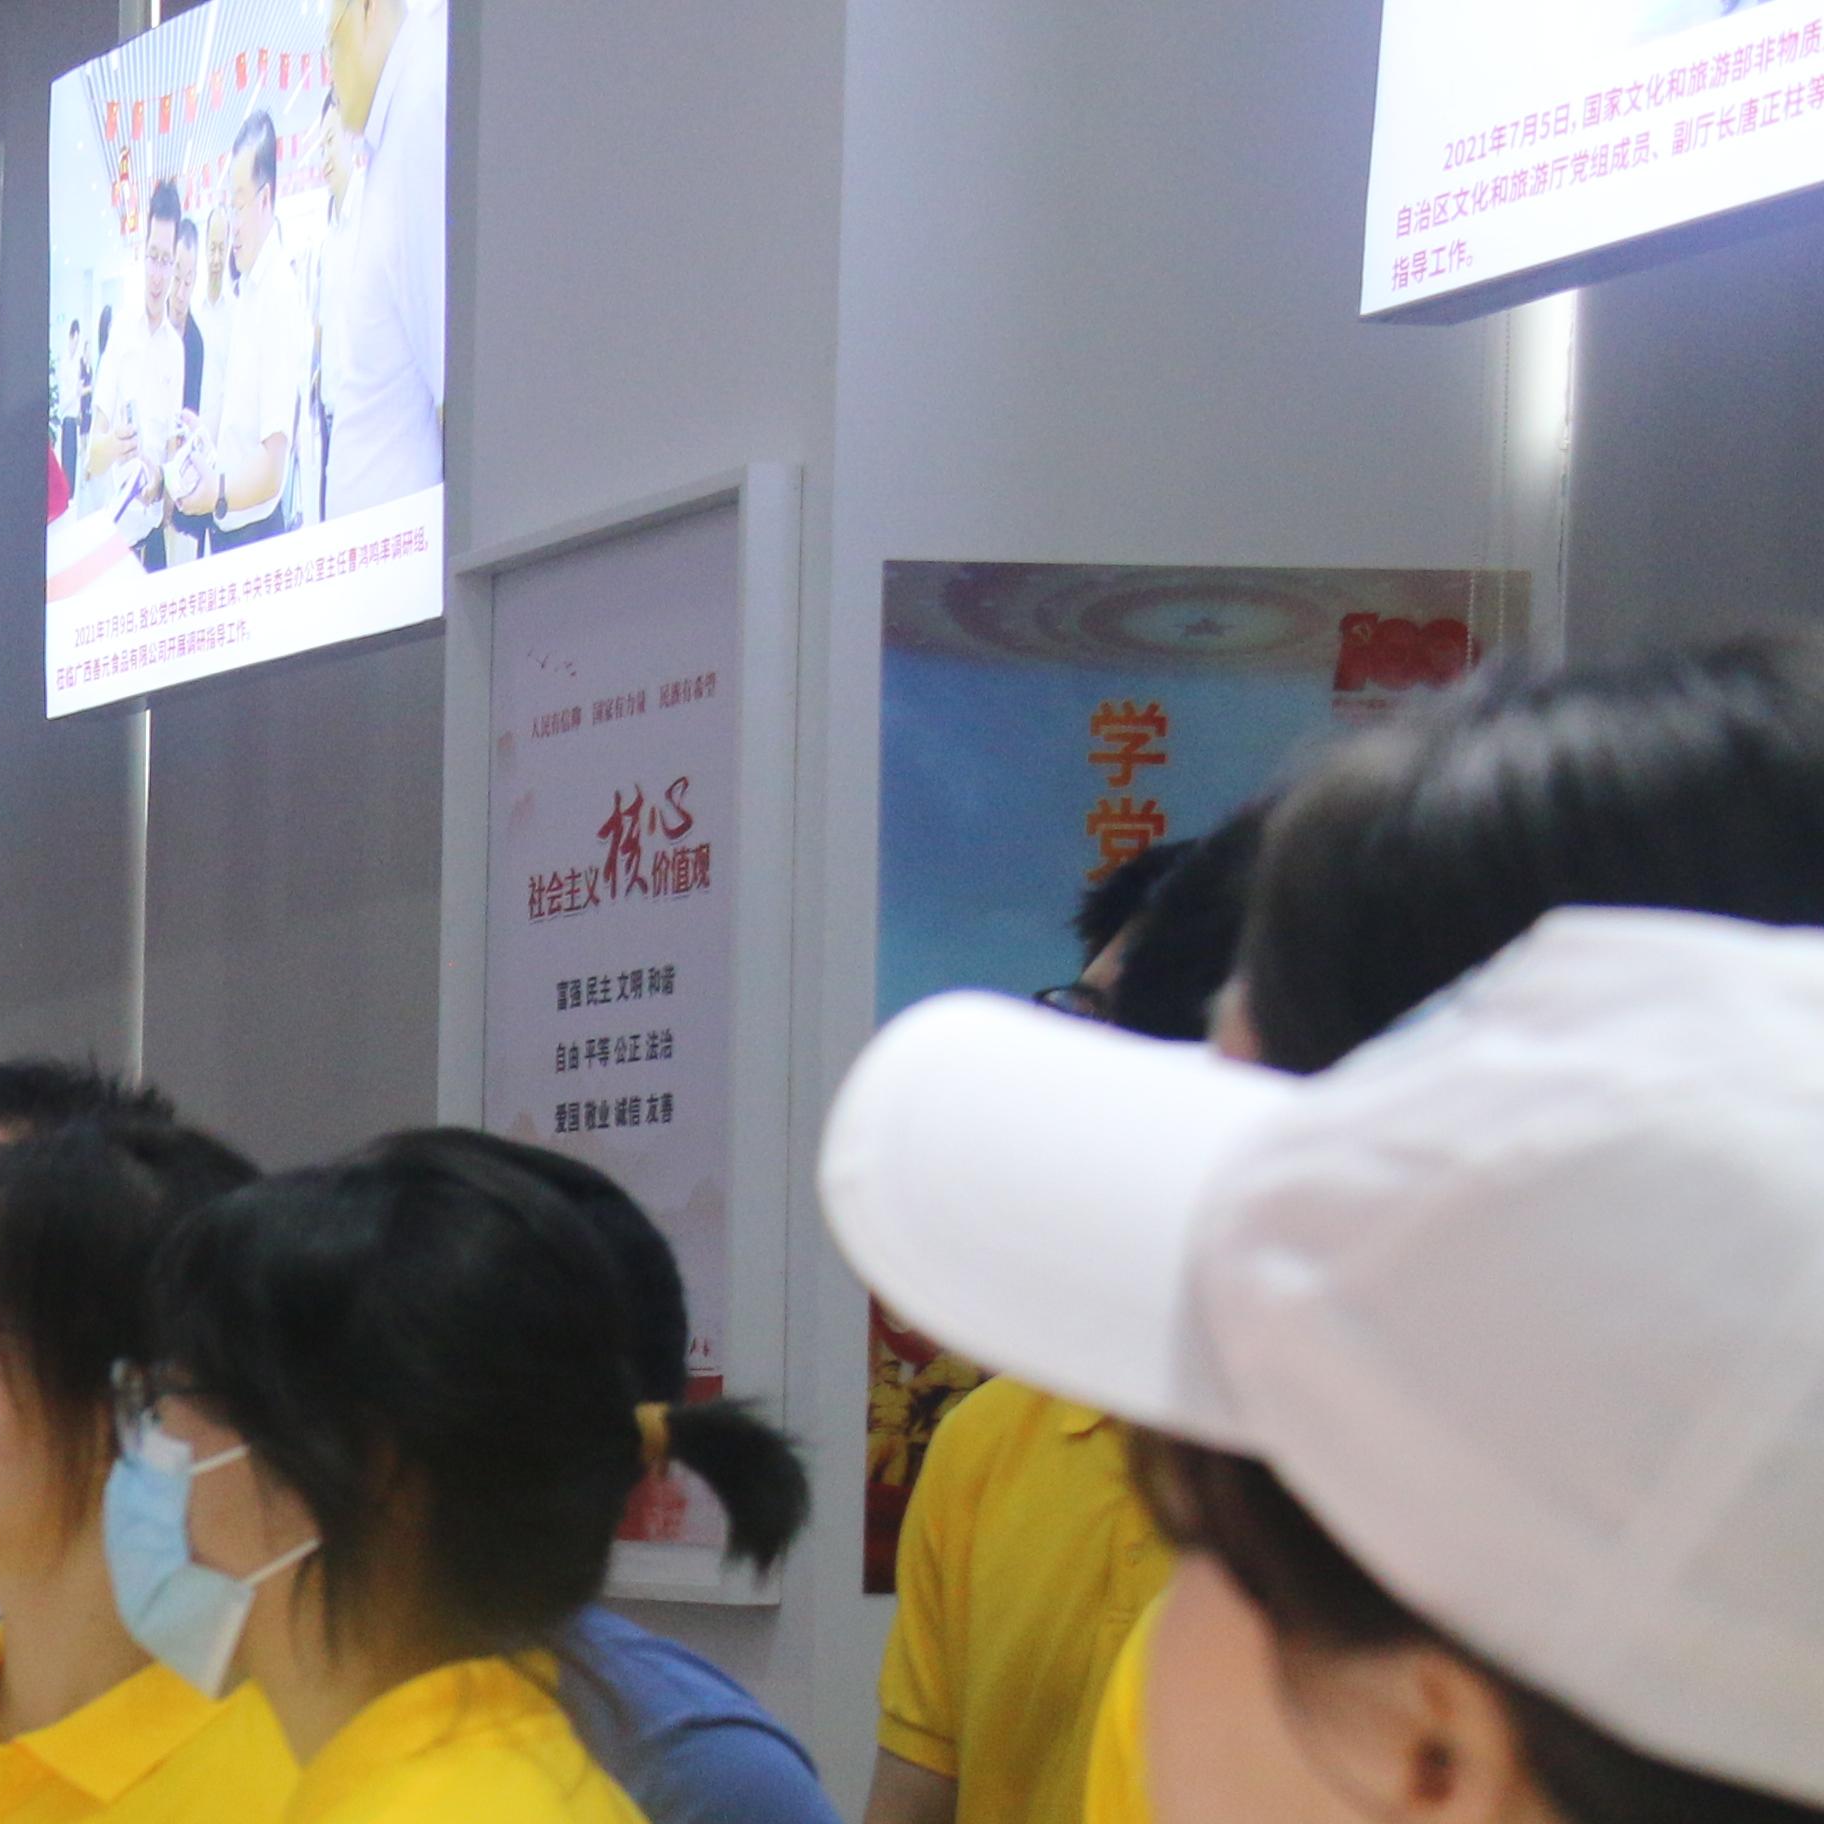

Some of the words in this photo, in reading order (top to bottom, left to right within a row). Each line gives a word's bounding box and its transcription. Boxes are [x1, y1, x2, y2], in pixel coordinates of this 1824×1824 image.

[1392, 239, 1473, 291] 指导工作。
[528, 864, 601, 920] 社会主义
[596, 775, 693, 900] 核心
[651, 842, 712, 898] 价值观
[556, 978, 582, 1012] 富强
[585, 974, 612, 1006] 民主
[615, 966, 644, 1001] 文明
[647, 964, 676, 997] 和谐
[555, 1042, 581, 1074] 自由
[584, 1036, 611, 1070] 平等
[614, 1033, 642, 1066] 公正
[645, 1027, 674, 1060] 法治
[554, 1101, 581, 1134] 爱国
[584, 1099, 611, 1131] 敬业
[614, 1095, 642, 1128] 诚信
[645, 1092, 675, 1126] 友善
